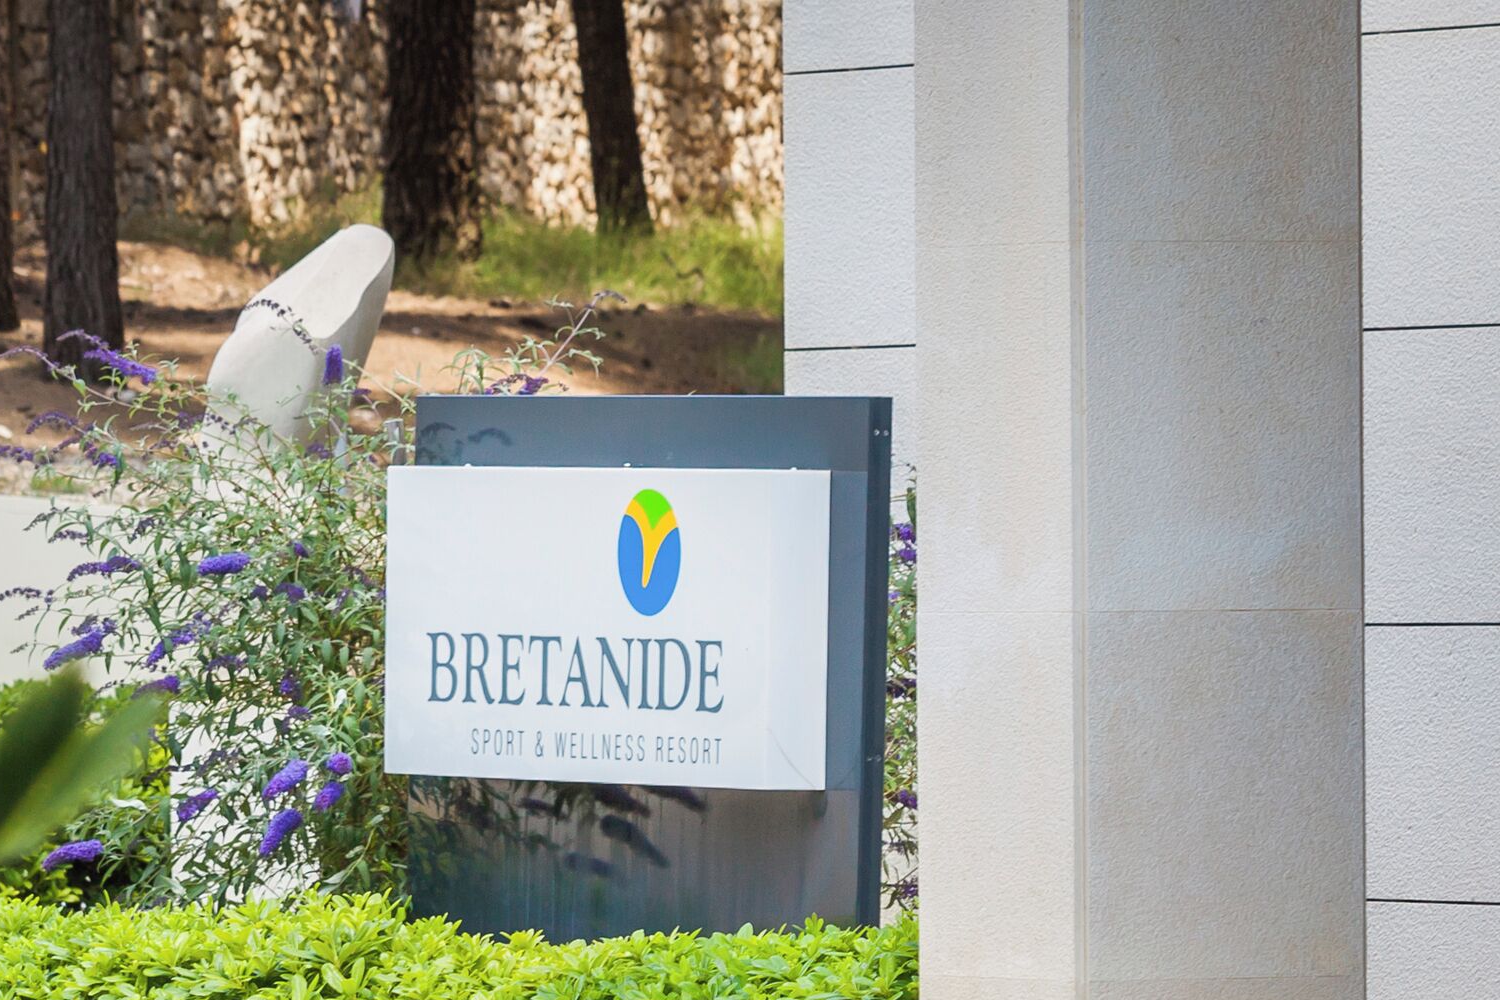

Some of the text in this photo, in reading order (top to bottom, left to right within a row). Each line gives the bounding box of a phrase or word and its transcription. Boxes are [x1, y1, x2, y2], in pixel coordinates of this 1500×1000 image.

[426, 632, 724, 713] BRETANIDE
[470, 728, 723, 765] SPORT & WELLNESS RESORT
